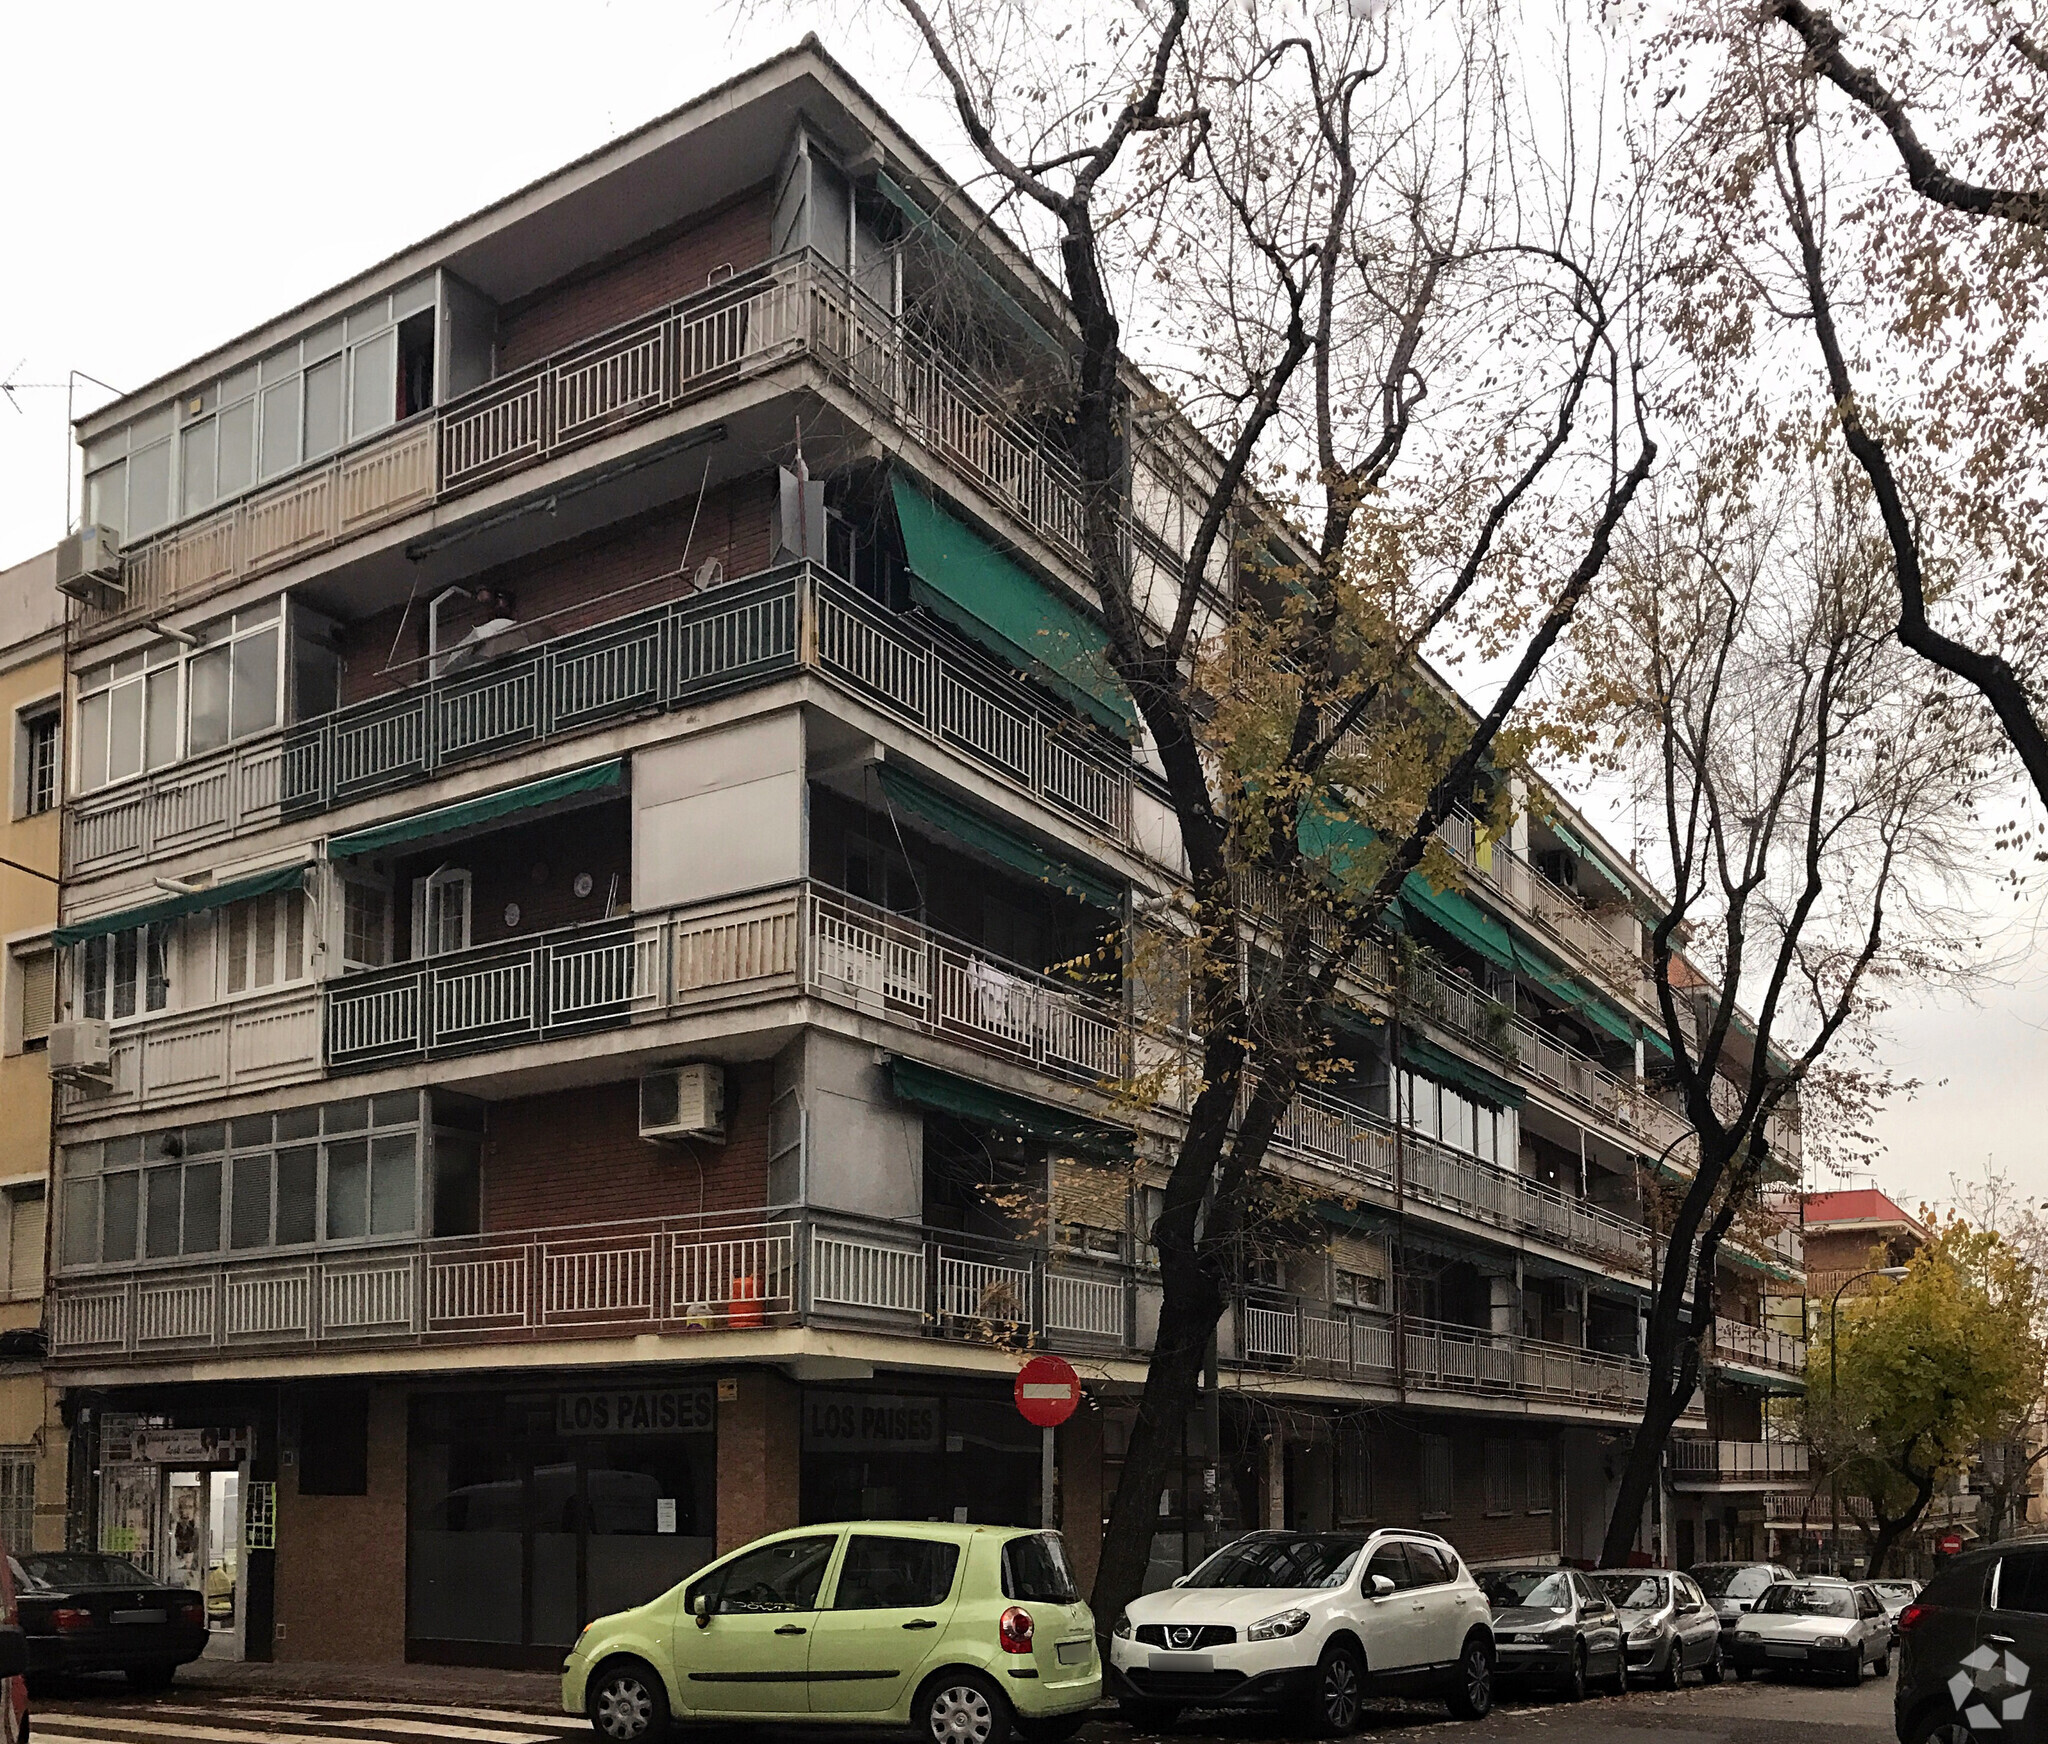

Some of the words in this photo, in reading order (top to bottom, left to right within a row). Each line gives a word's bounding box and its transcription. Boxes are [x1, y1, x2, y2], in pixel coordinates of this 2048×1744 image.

[560, 1396, 610, 1429] LOS
[617, 1392, 712, 1429] PAISES
[811, 1403, 855, 1439] LOS
[861, 1406, 933, 1441] PAISES
